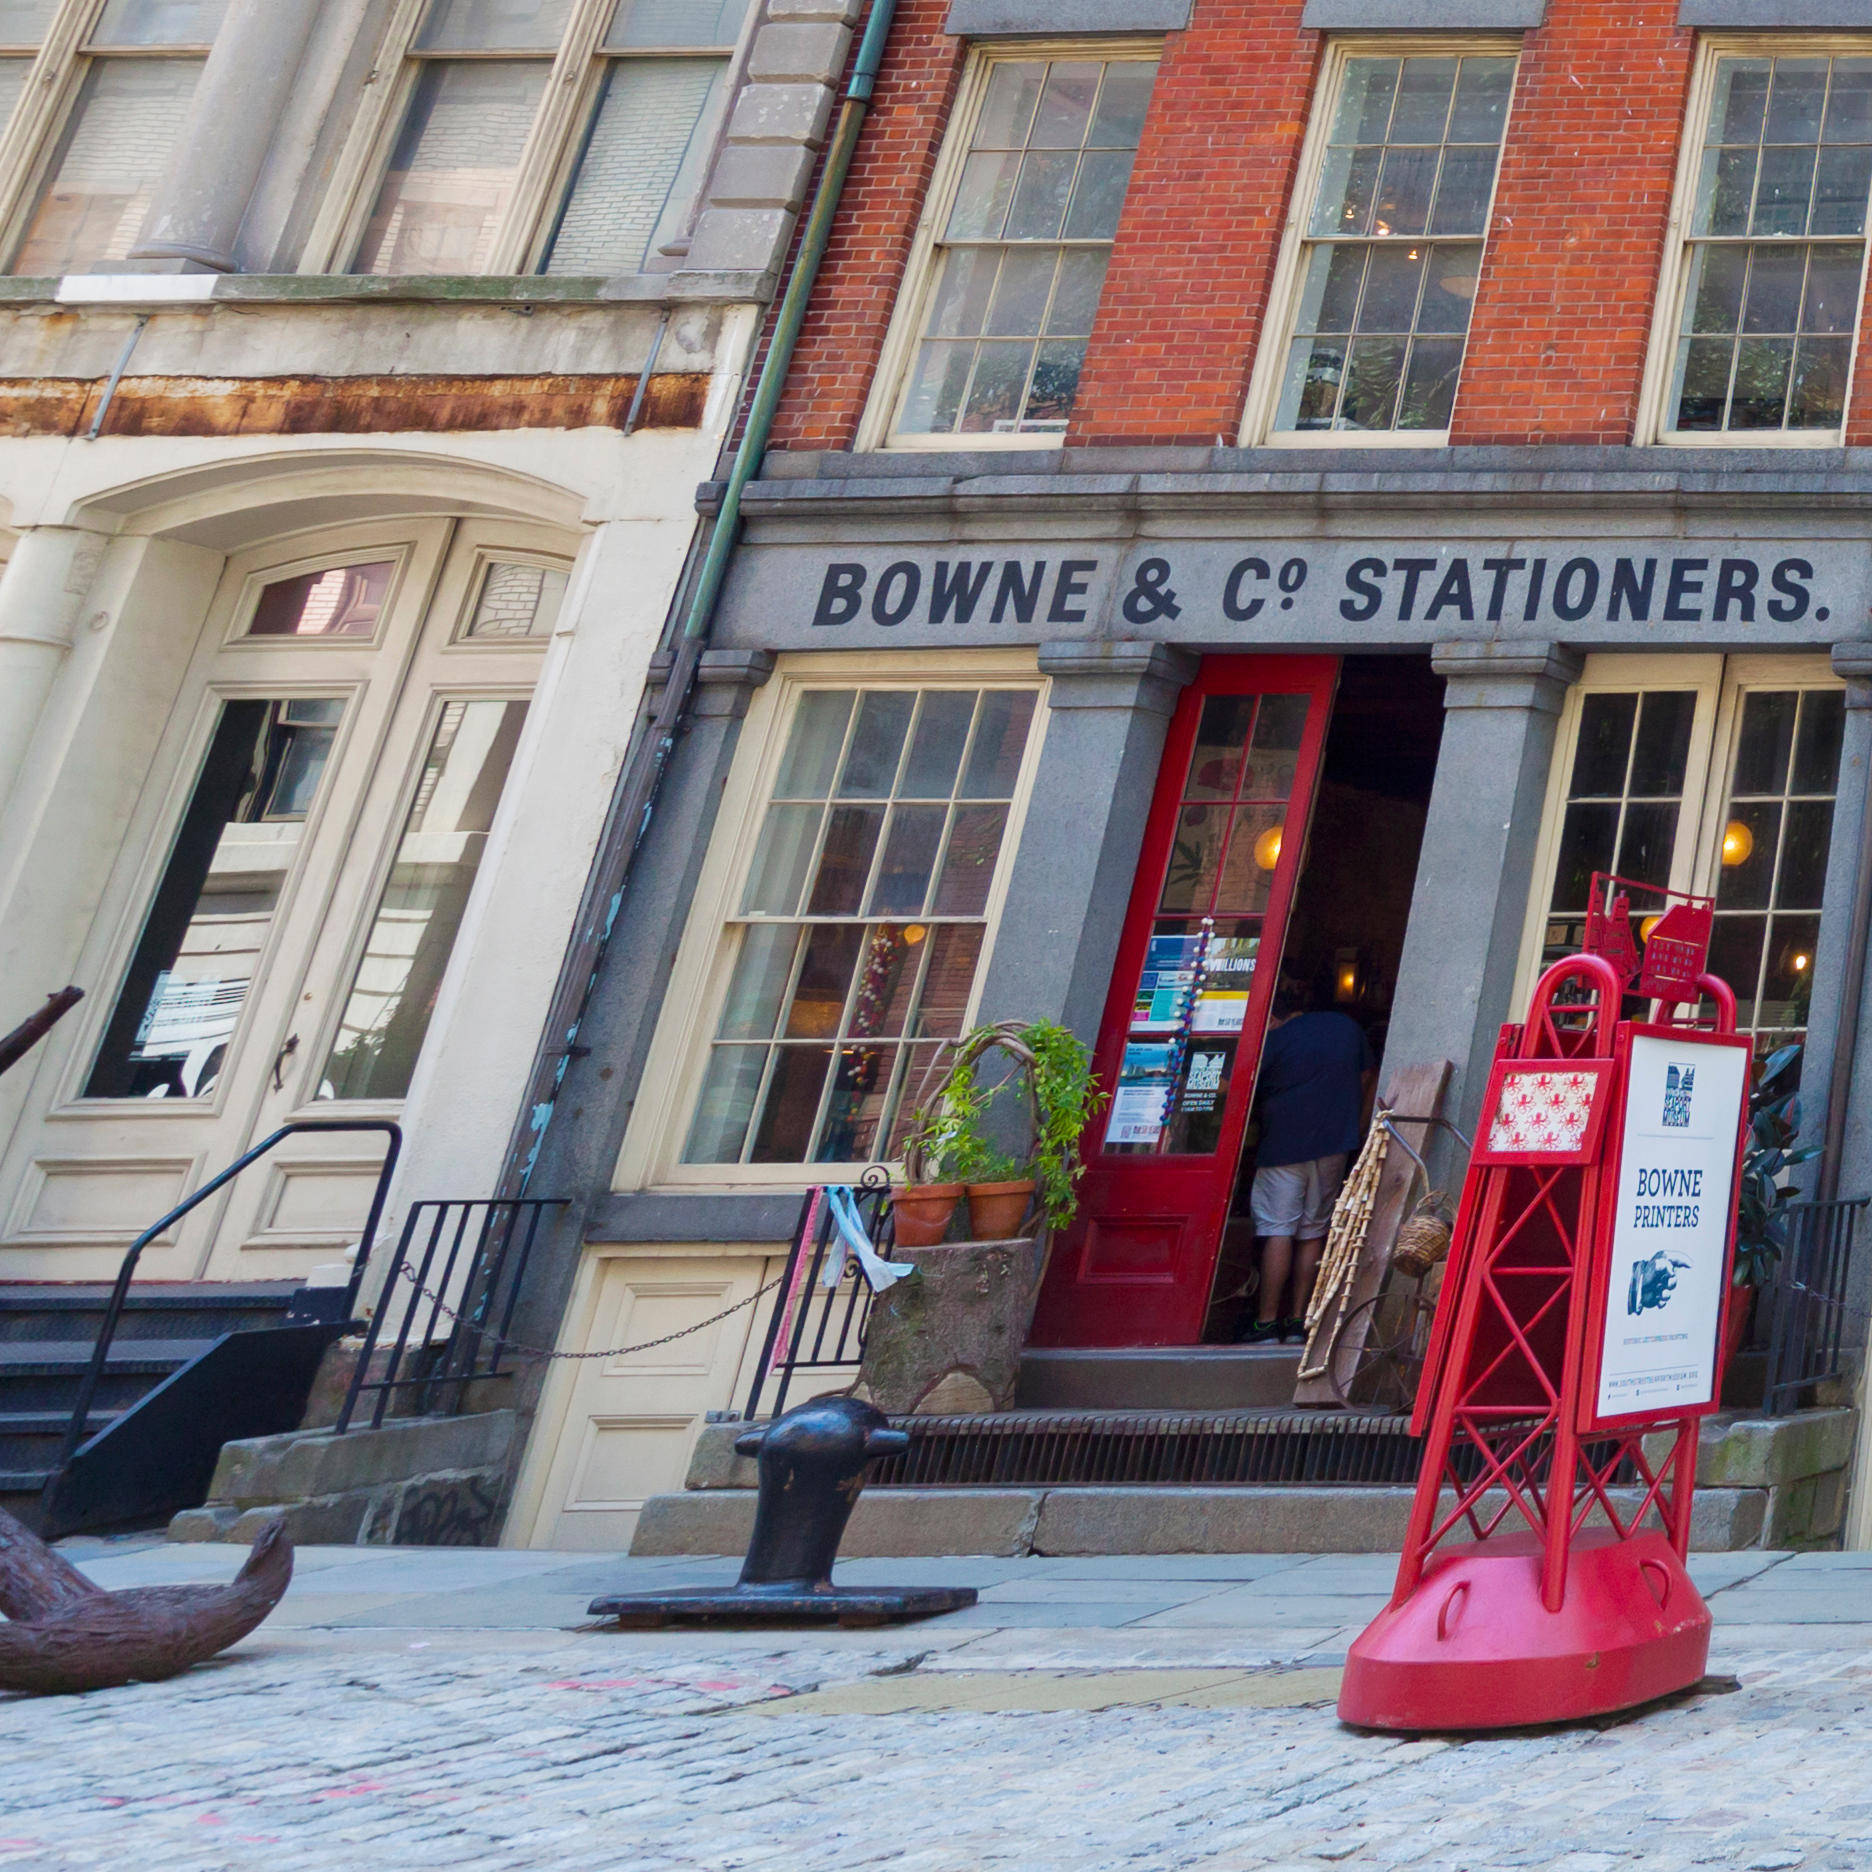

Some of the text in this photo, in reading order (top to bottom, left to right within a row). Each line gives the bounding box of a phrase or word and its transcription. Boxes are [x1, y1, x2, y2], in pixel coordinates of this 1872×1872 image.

[812, 559, 1097, 627] BOWNE
[1121, 557, 1181, 625] &
[1340, 556, 1831, 624] STATIONERS.
[1636, 1168, 1703, 1198] BOWNE
[1633, 1204, 1700, 1229] PRINTERS
